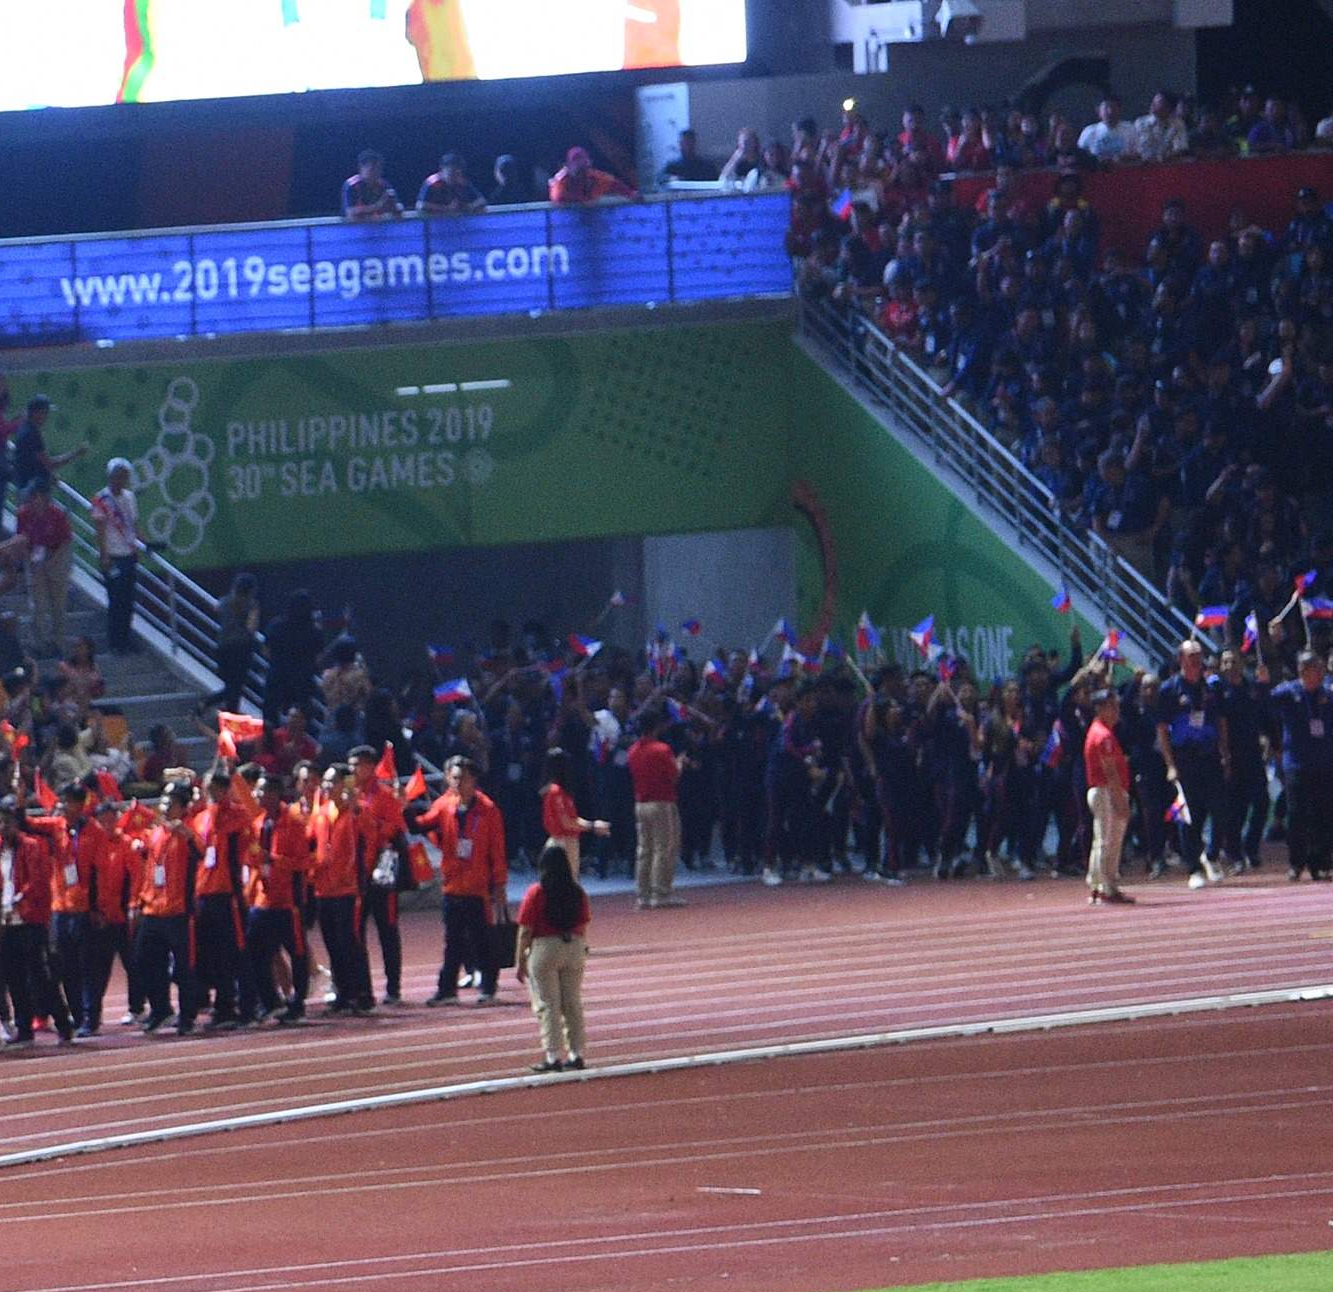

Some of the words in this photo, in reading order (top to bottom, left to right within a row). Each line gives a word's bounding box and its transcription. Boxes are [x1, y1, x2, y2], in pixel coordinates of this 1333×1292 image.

[60, 243, 570, 308] www.2019seagames.com
[227, 409, 421, 457] PHILIPPINES
[426, 403, 495, 445] 2019
[280, 459, 338, 497] SEA
[346, 451, 456, 492] GAMES
